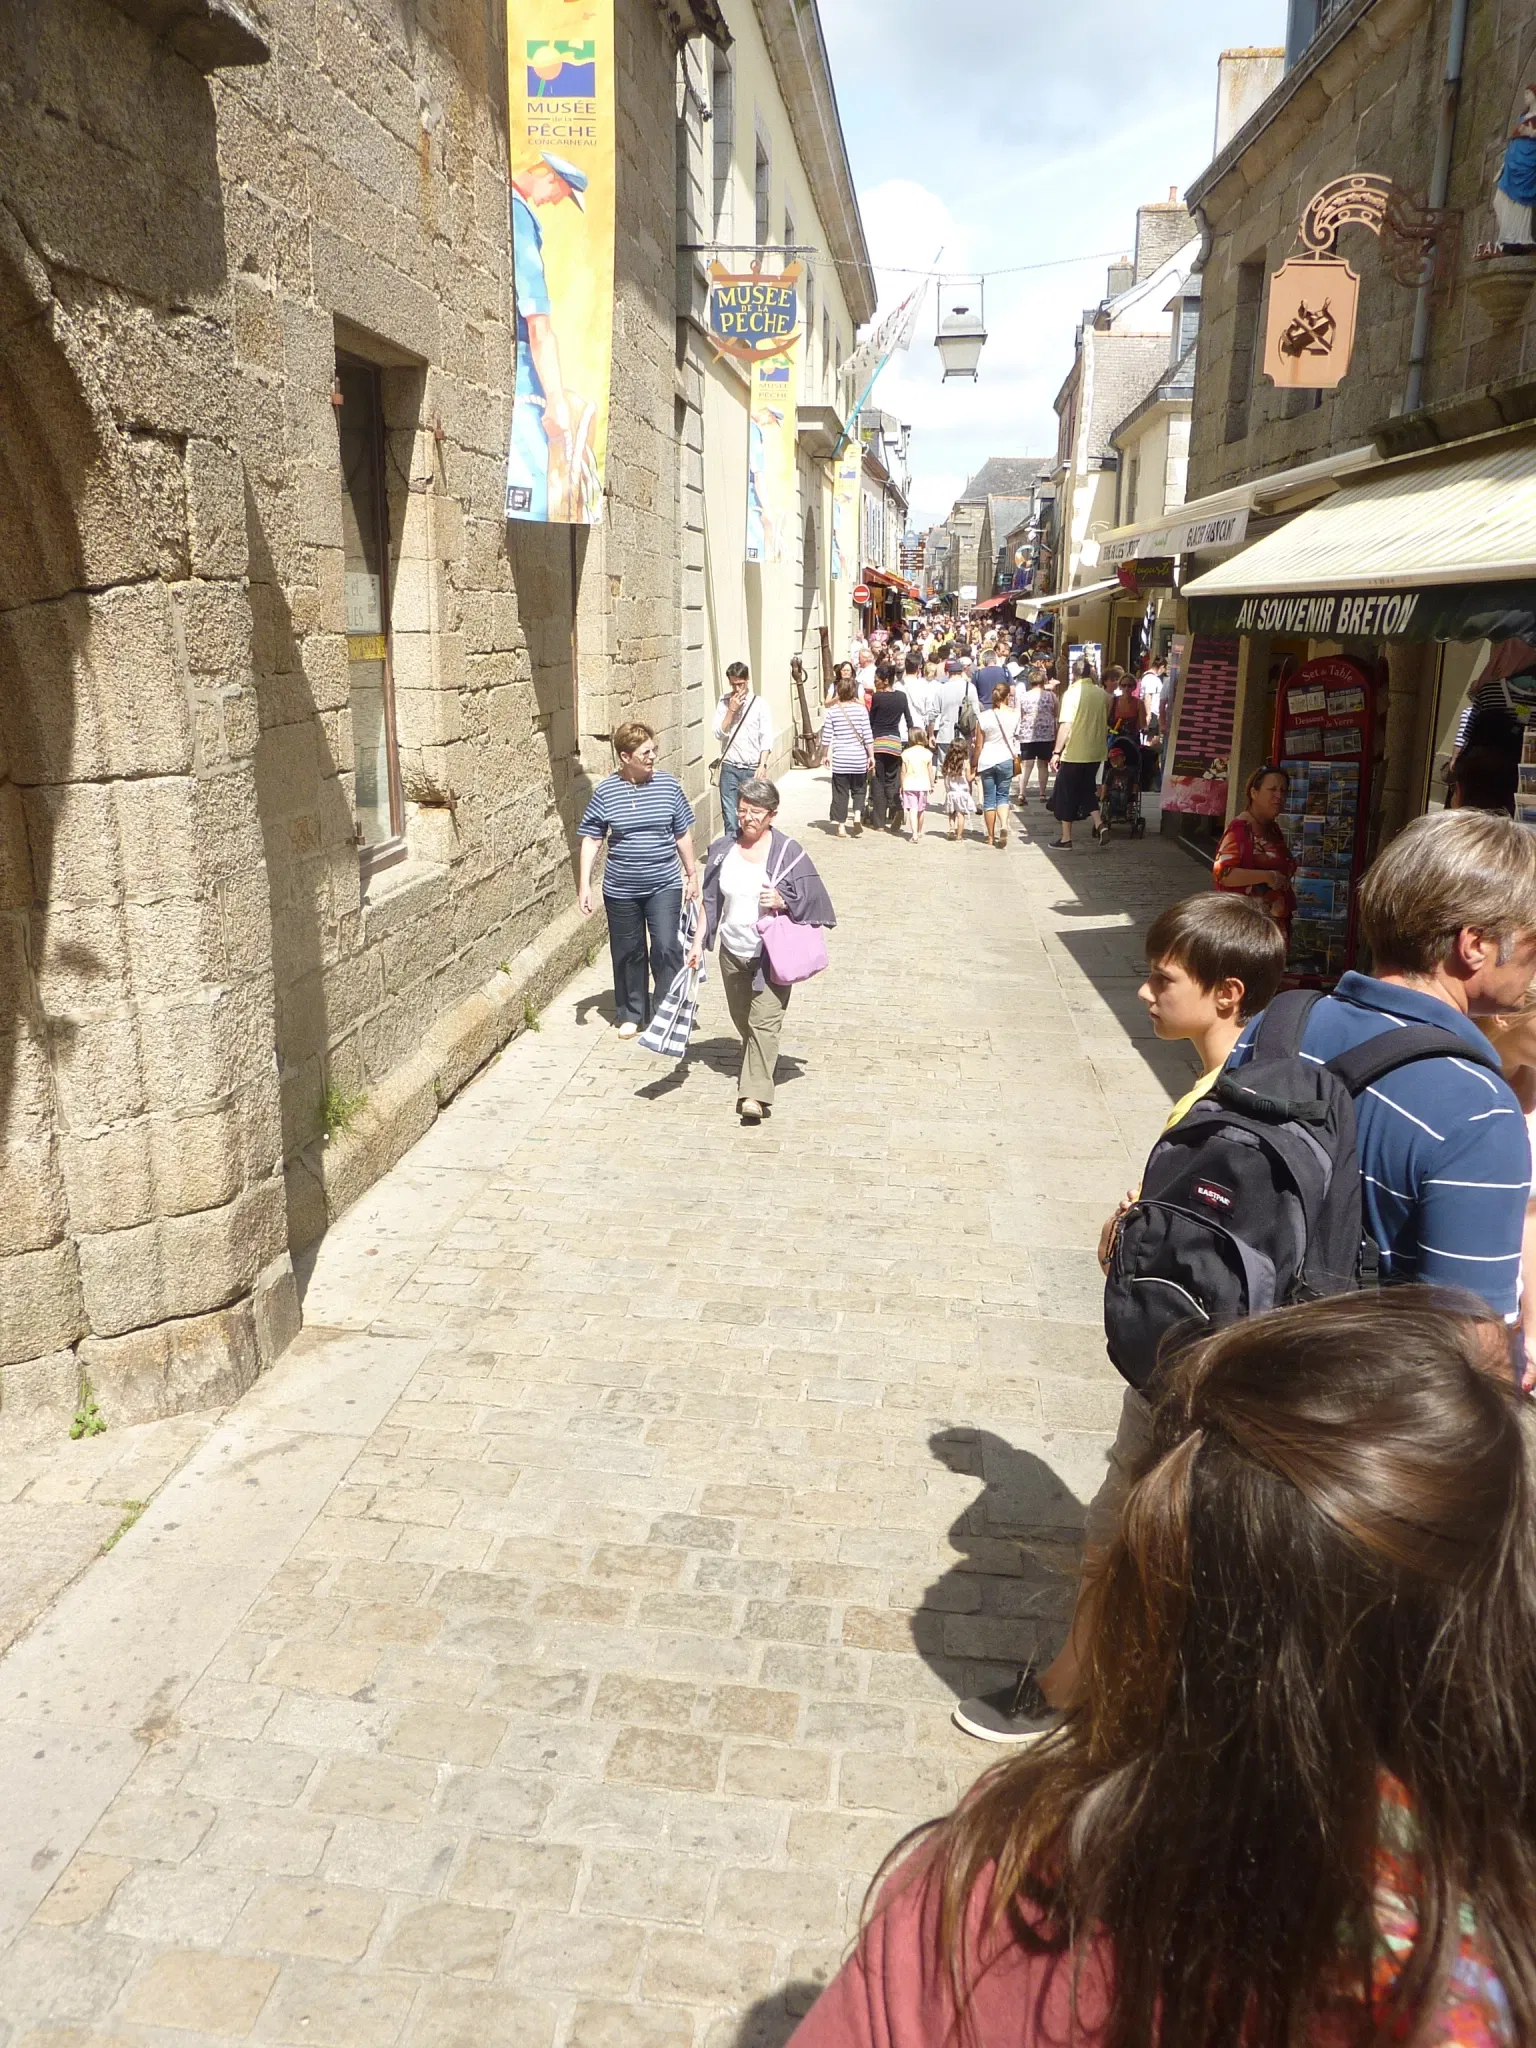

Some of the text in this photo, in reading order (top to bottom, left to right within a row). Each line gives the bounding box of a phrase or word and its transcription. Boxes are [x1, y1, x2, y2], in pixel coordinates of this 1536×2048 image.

[527, 99, 597, 114] MUSÉE
[527, 123, 597, 138] PÊCHE
[527, 139, 598, 147] CONCARNEAU
[717, 286, 793, 308] MUSEE
[741, 304, 769, 312] DE LA
[720, 312, 790, 334] PECHE
[1235, 594, 1420, 635] AU SOUVENIR BRETON
[1301, 669, 1319, 682] Set
[1328, 664, 1353, 683] Table
[1334, 718, 1354, 726] Verre
[1197, 1186, 1231, 1206] EASTPAK
